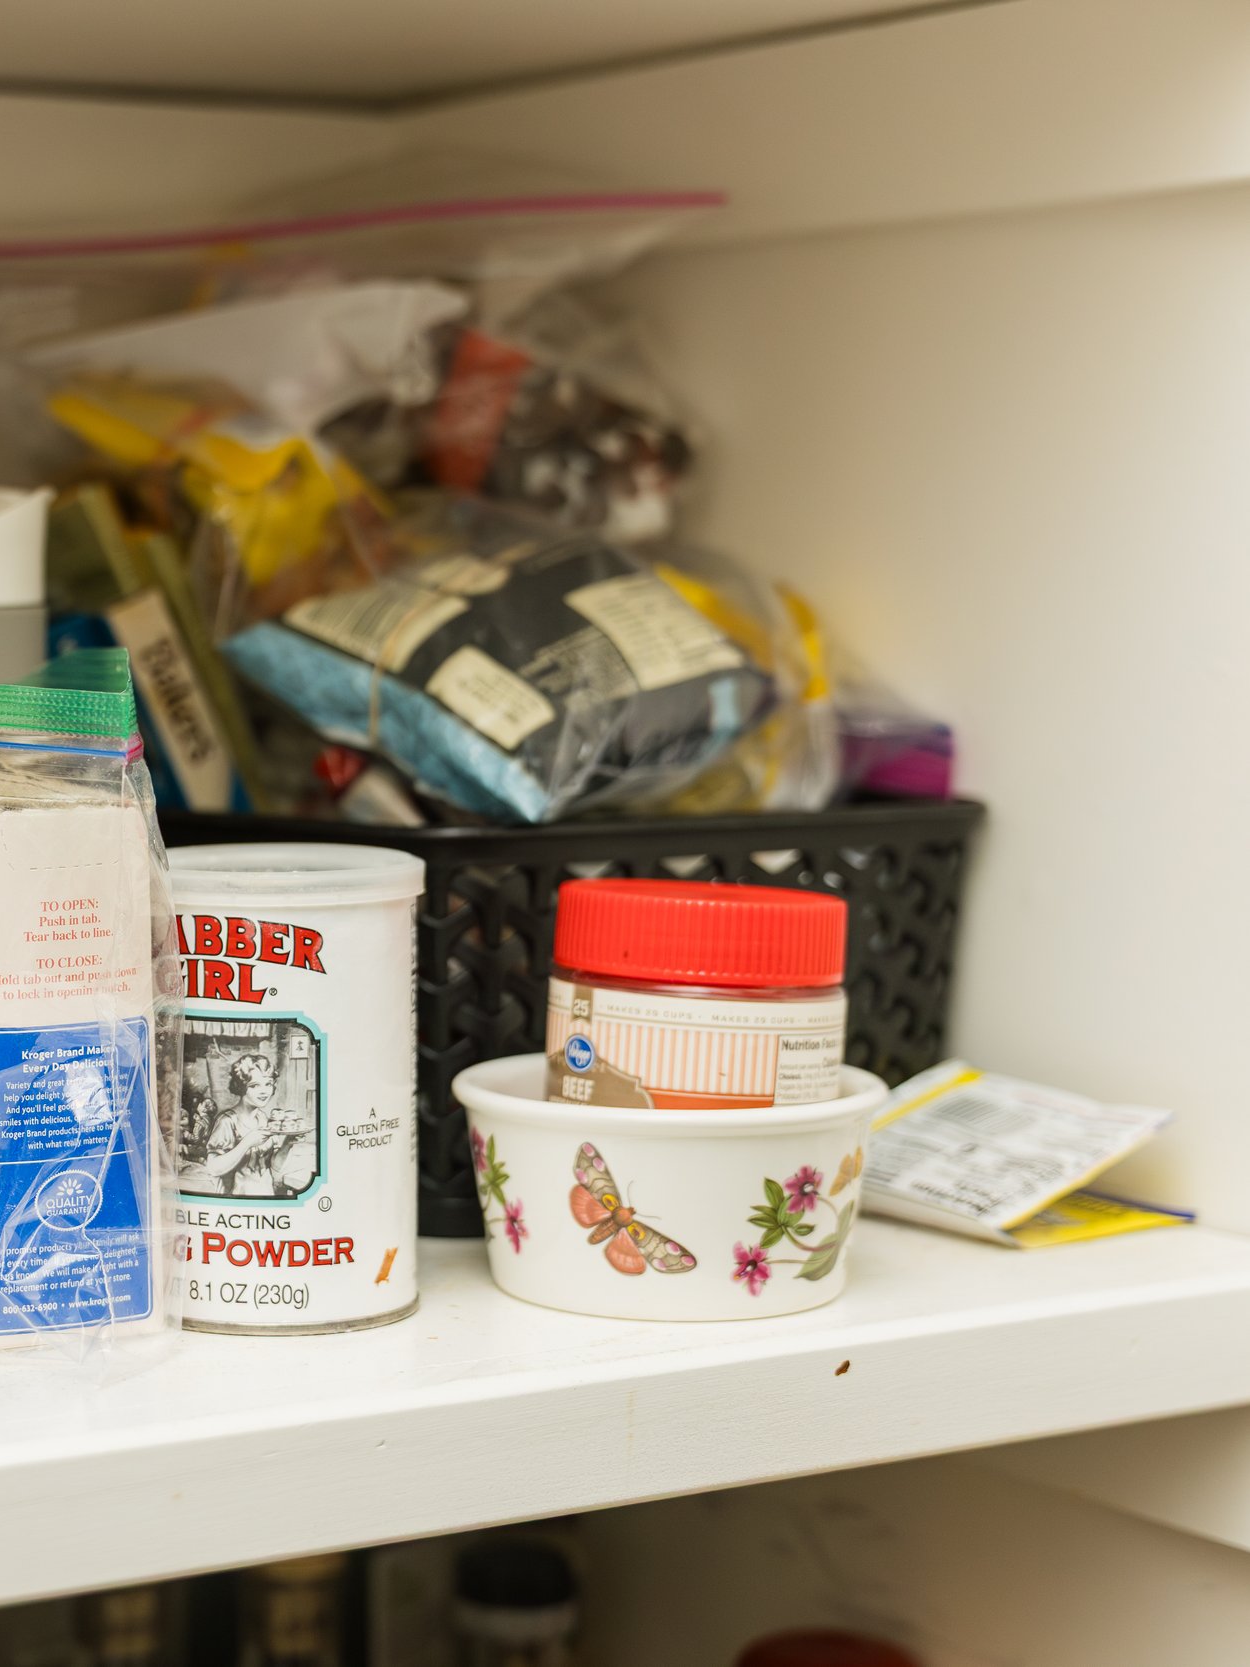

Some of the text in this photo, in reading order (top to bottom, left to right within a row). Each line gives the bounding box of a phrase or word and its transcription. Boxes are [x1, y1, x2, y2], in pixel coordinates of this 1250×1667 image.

[41, 898, 99, 913] TO OPEN:
[39, 913, 101, 927] Push in tab.
[23, 927, 114, 942] Tear back to line.
[36, 955, 103, 970] TO CLOSE:
[23, 973, 42, 985] tab
[44, 972, 62, 984] out
[64, 971, 85, 983] and
[181, 958, 268, 1005] IRL
[3, 990, 15, 1000] to
[17, 988, 40, 1000] lock
[44, 987, 54, 998] in
[57, 986, 98, 999] openin
[781, 1039, 821, 1051] Nutrition
[21, 1050, 55, 1062] Kroger
[57, 1046, 84, 1058] Brand
[23, 1059, 114, 1075] Every Day Deliciou
[6, 1081, 31, 1091] Variety
[33, 1079, 46, 1089] and
[47, 1078, 65, 1089] great
[562, 1074, 596, 1102] BEEF
[3, 1093, 20, 1104] help
[21, 1094, 35, 1103] you
[36, 1091, 61, 1102] delight
[6, 1105, 21, 1114] And
[22, 1104, 42, 1115] you'll
[43, 1102, 56, 1112] feel
[368, 1107, 377, 1119] A
[0, 1118, 22, 1127] smiles
[23, 1116, 40, 1126] with
[40, 1115, 73, 1125] delicious,
[336, 1117, 401, 1137] GLUTEN FREE
[1, 1130, 25, 1141] Kroger
[26, 1128, 47, 1138] Brand
[81, 1124, 96, 1133] here
[27, 1140, 44, 1150] with
[45, 1138, 62, 1148] what
[83, 1136, 109, 1145] matters.
[348, 1133, 393, 1151] PRODUCT
[45, 1194, 93, 1209] QUALITY
[215, 1212, 291, 1230] ACTING
[39, 1242, 72, 1255] products
[116, 1234, 127, 1244] will
[129, 1231, 140, 1242] ask
[202, 1231, 355, 1268] POWDER
[56, 1266, 70, 1277] will
[72, 1265, 91, 1275] make
[118, 1259, 134, 1269] with
[0, 1282, 48, 1295] replacement
[49, 1281, 58, 1290] or
[60, 1278, 84, 1290] refund
[94, 1276, 112, 1287] yor
[113, 1272, 132, 1283] store.
[189, 1279, 212, 1302] 8.1
[220, 1282, 248, 1304] OZ
[254, 1283, 310, 1310] (230g)
[2, 1302, 58, 1315] 800-632-6900
